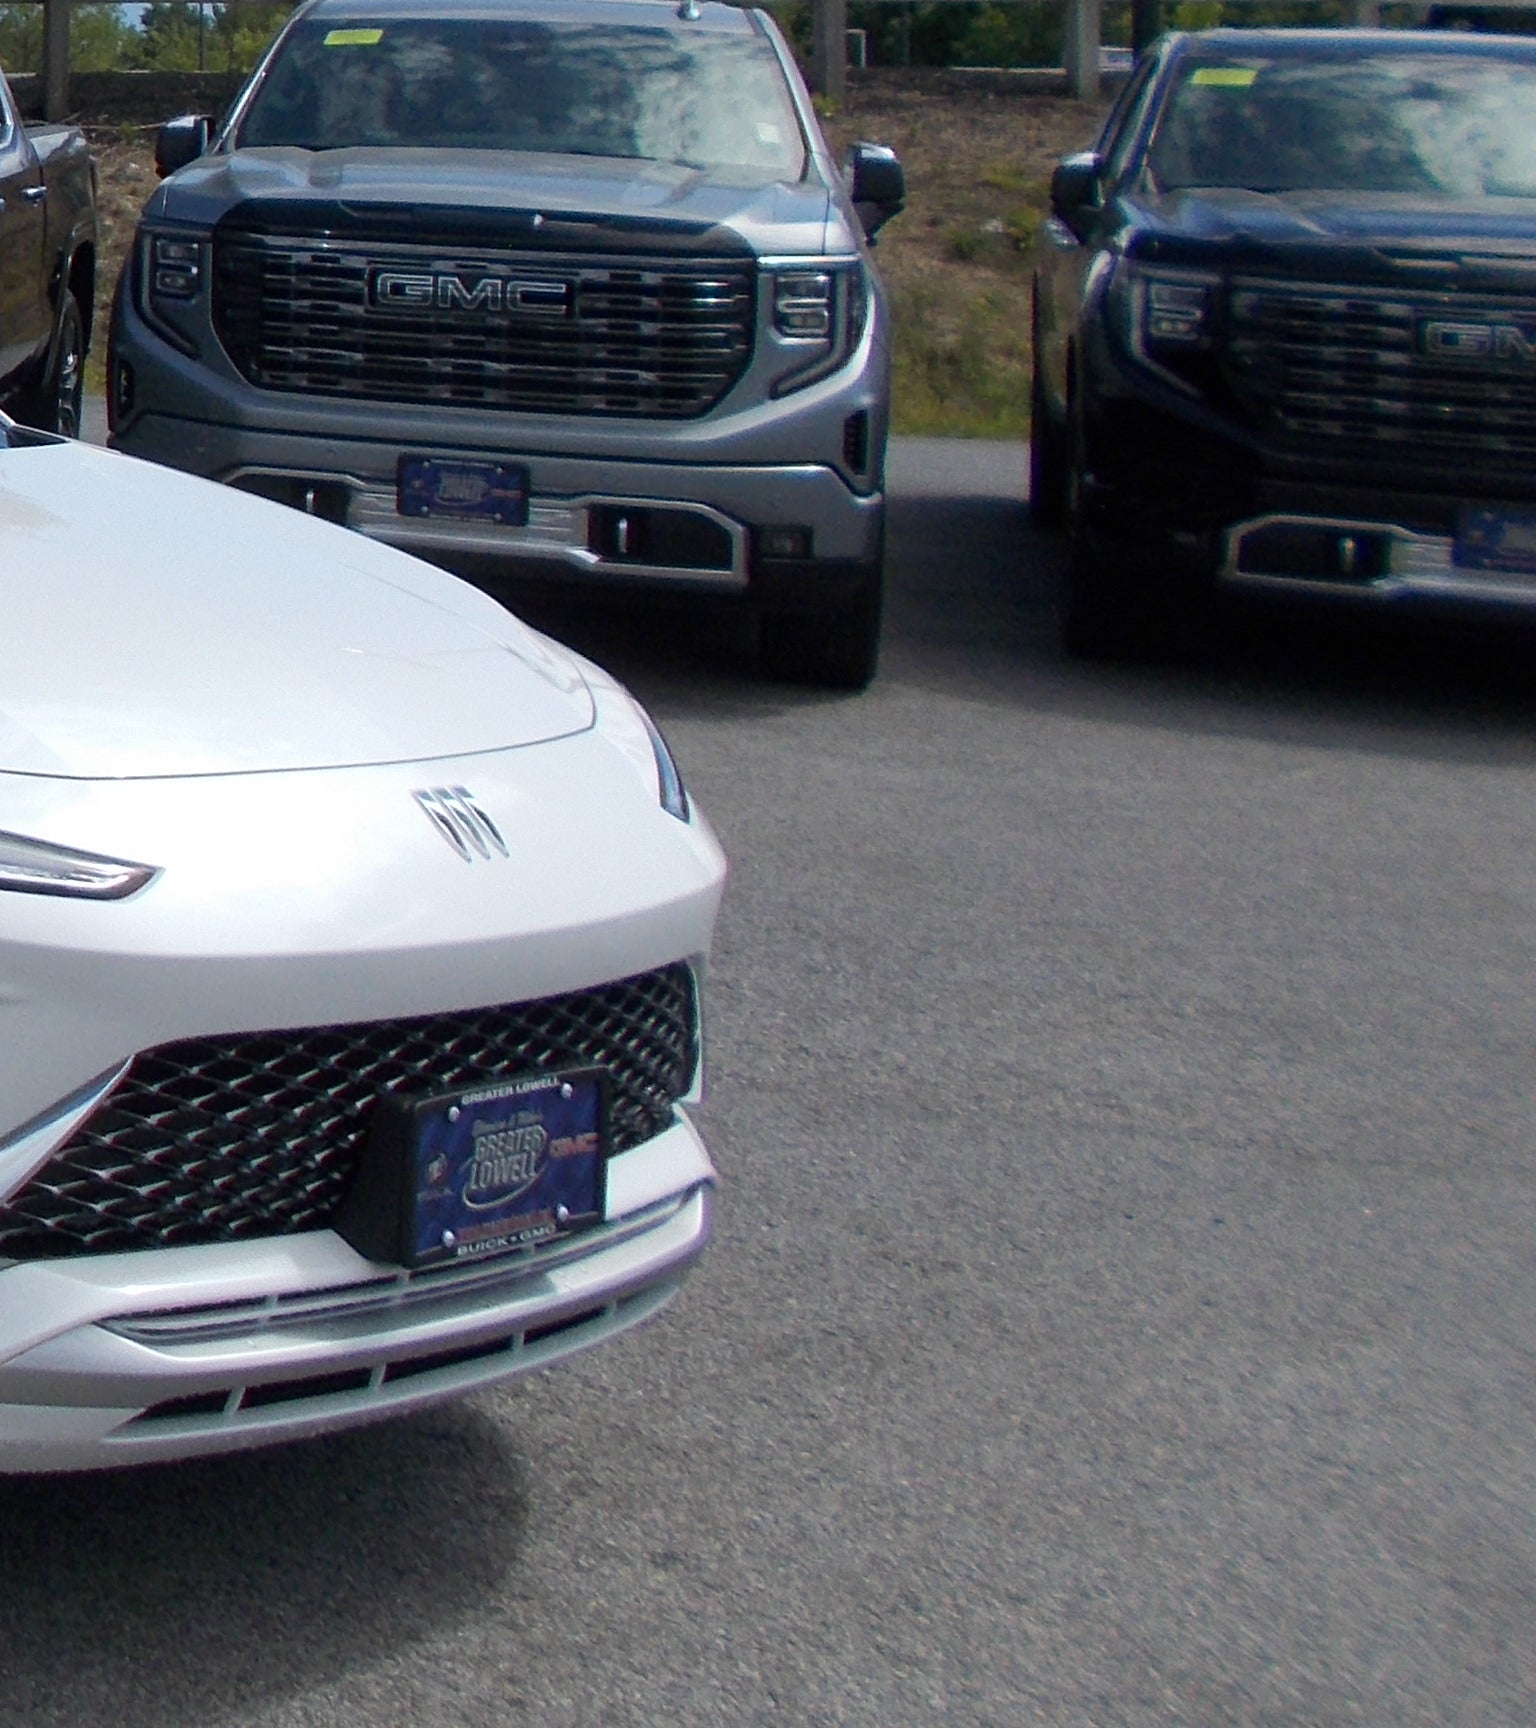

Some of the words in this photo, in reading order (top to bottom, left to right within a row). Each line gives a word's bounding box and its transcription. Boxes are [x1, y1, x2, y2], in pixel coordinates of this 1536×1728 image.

[378, 273, 568, 314] GMC
[515, 1076, 561, 1094] LOWELL
[469, 1151, 537, 1190] LOWELL
[457, 1235, 509, 1256] BUICK
